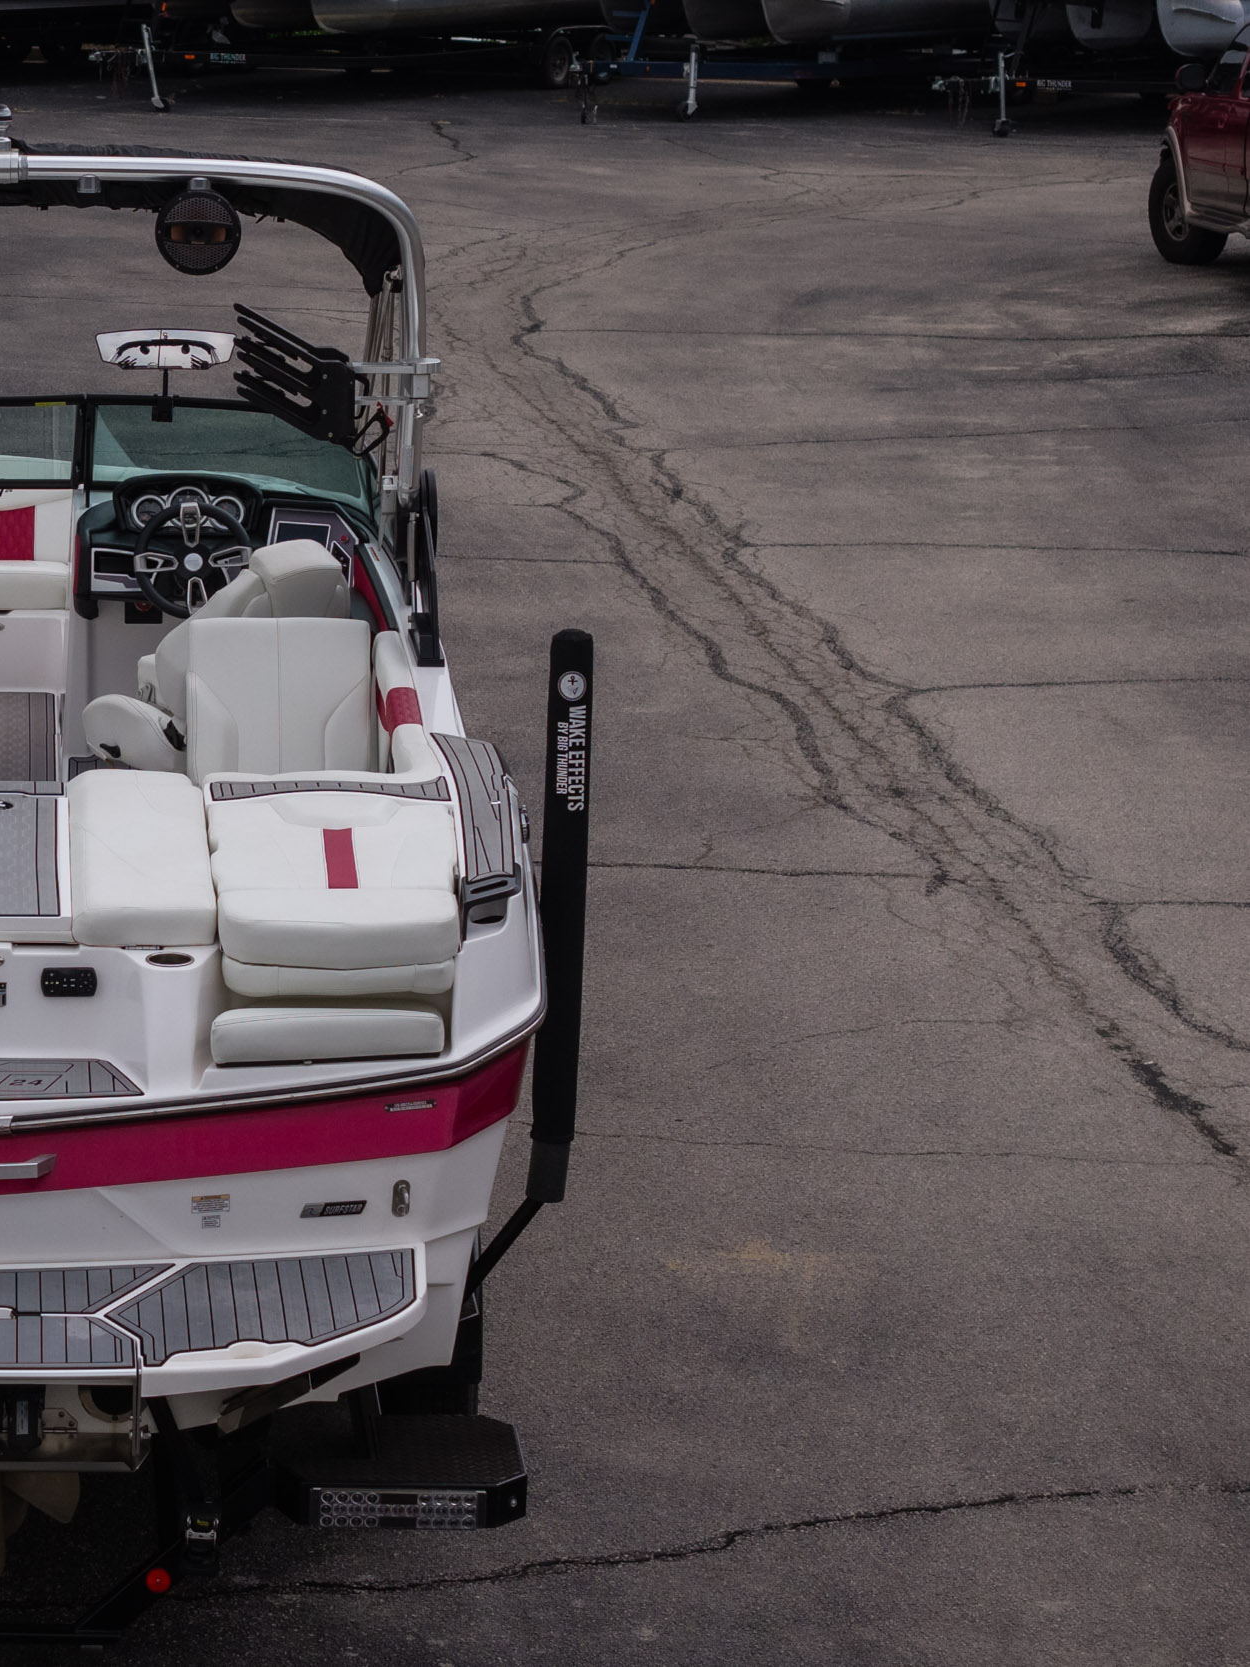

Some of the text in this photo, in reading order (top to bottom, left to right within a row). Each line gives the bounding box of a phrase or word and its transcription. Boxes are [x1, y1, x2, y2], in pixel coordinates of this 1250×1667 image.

[221, 53, 246, 61] THUNDER
[555, 721, 569, 795] BY BIG THUNDER
[567, 704, 587, 812] WAKE EFFECTS
[324, 1203, 363, 1216] SURFSTAR
